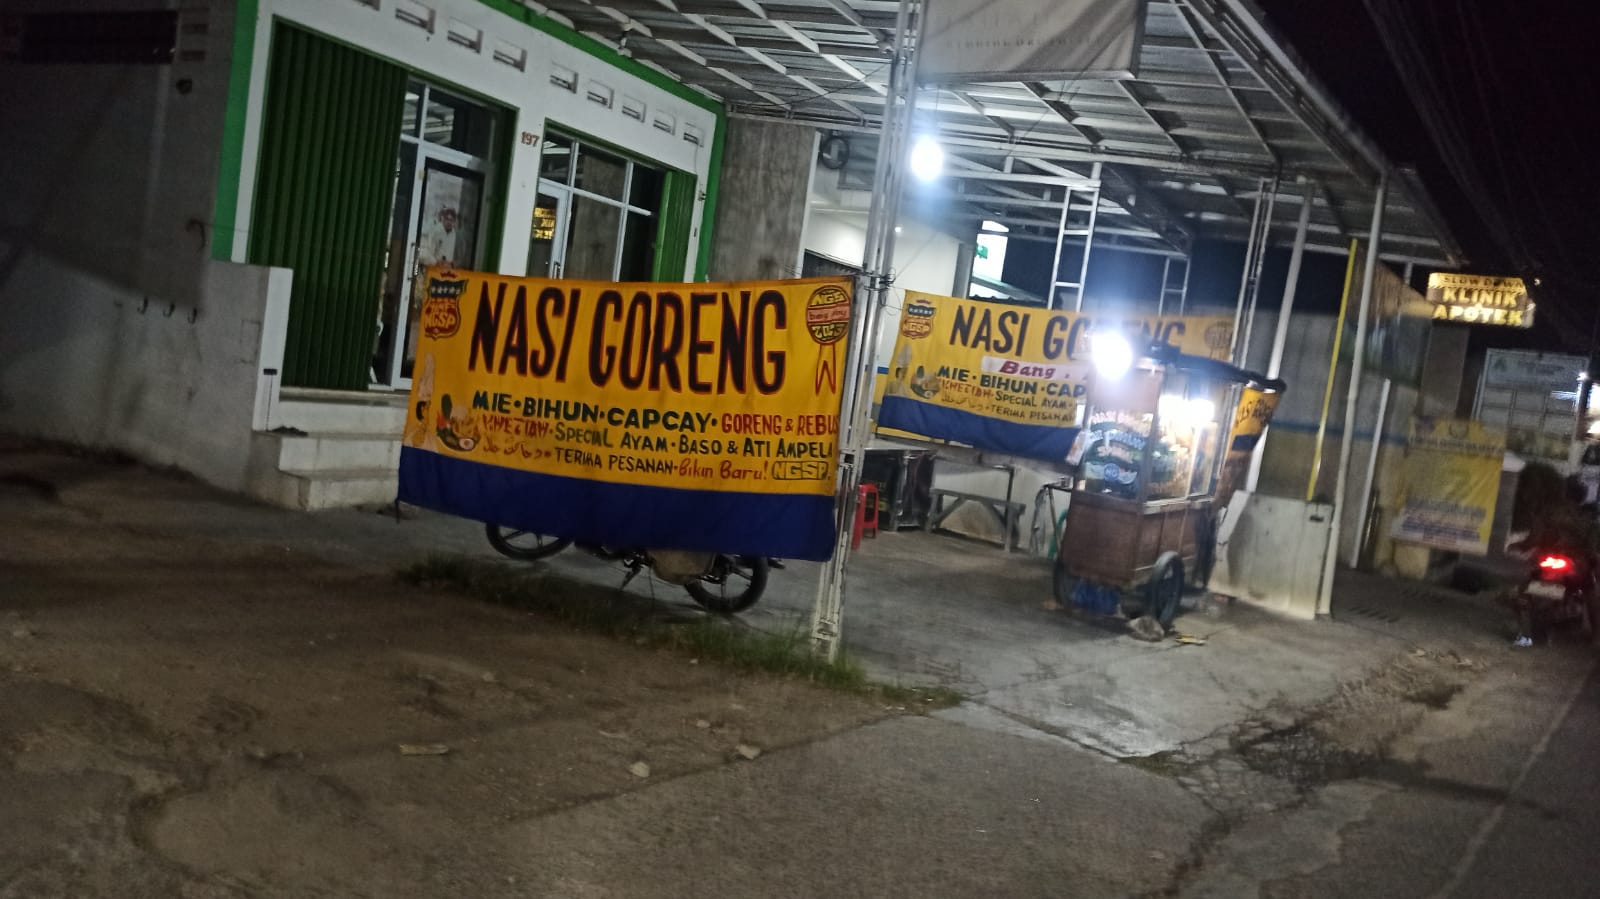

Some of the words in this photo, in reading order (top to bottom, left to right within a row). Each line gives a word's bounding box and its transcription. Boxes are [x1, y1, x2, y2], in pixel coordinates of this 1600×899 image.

[521, 131, 540, 147] 197
[1442, 288, 1518, 307] KLINIK
[1433, 304, 1523, 326] APOTEK
[468, 280, 581, 382] NASI
[588, 289, 787, 395] GORENG
[949, 305, 1030, 356] NASI
[937, 366, 970, 382] MIE
[980, 375, 1037, 394] BIHUN
[1046, 383, 1087, 397] CAP
[999, 361, 1056, 379] Bang
[472, 390, 512, 414] MIE
[522, 397, 599, 423] BIHUN
[607, 407, 712, 433] CAPCAY
[721, 413, 782, 435] GORENG
[785, 418, 794, 432] &
[991, 404, 1025, 418] TERIMA
[995, 391, 1038, 407] SPECIAL
[1041, 397, 1067, 409] AYAM
[555, 422, 613, 447] SPECIAL
[621, 432, 667, 452] AYAM
[679, 435, 722, 455] BASO
[727, 440, 738, 454] &
[743, 437, 770, 457] ATI
[555, 448, 602, 468] TERIMA
[608, 455, 674, 474] PESANAN
[679, 458, 713, 479] Bikin
[720, 460, 768, 480] Baru!
